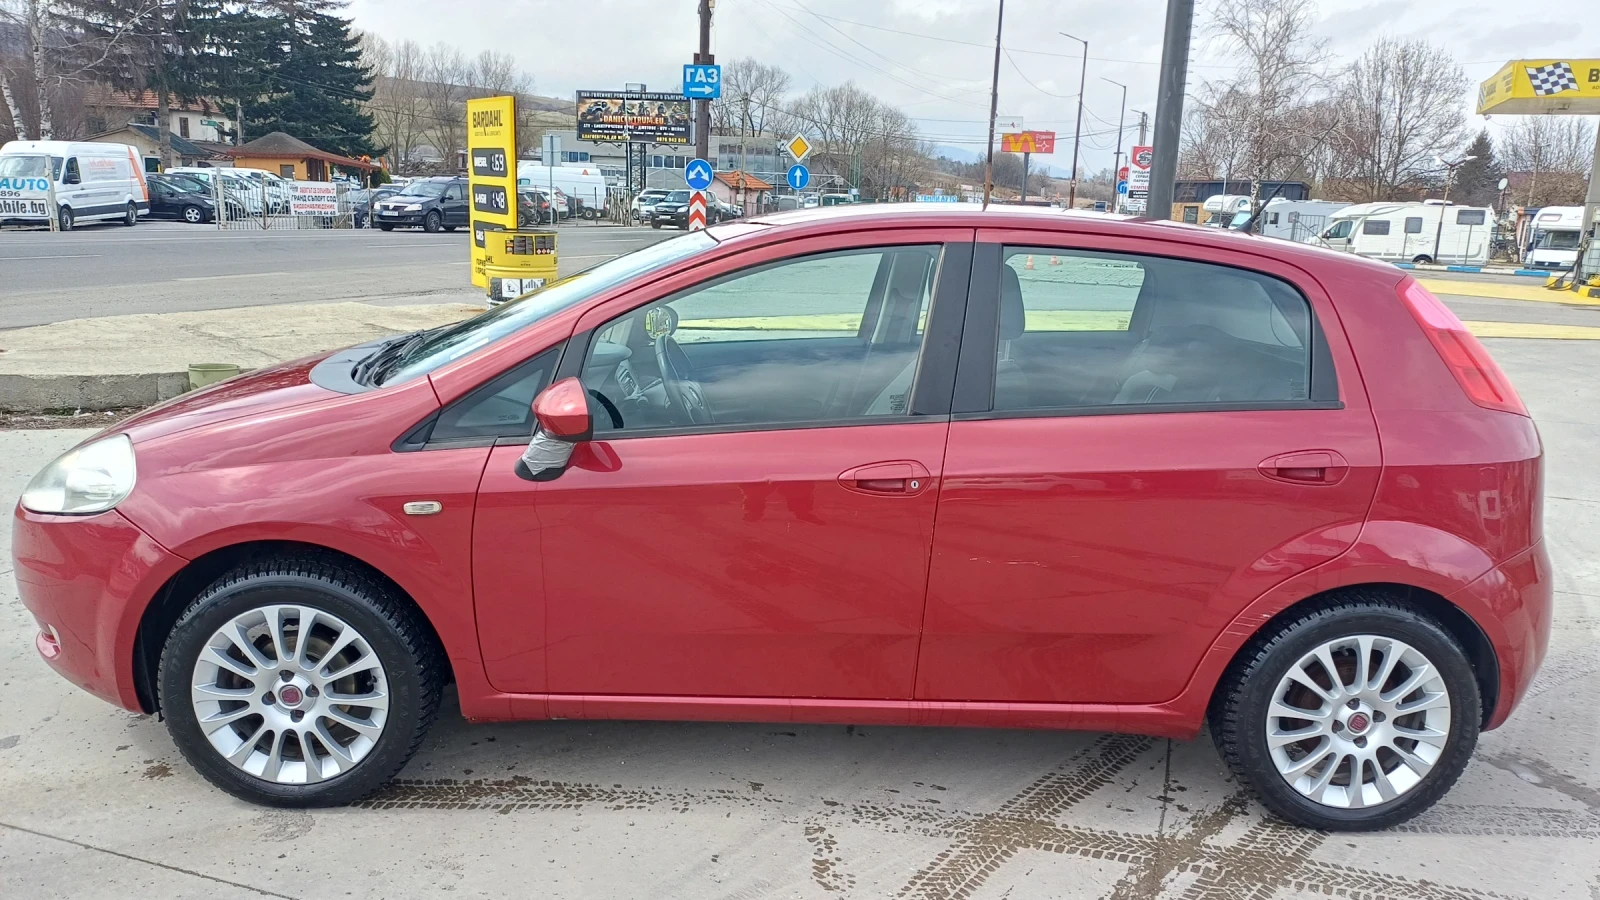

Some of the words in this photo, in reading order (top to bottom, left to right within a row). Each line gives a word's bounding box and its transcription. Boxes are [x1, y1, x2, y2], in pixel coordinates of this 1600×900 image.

[685, 68, 718, 83] ГАЗ
[472, 110, 503, 133] BARDAHL
[603, 115, 664, 125] DANICNTRUM.EU
[0, 178, 48, 190] AUTO
